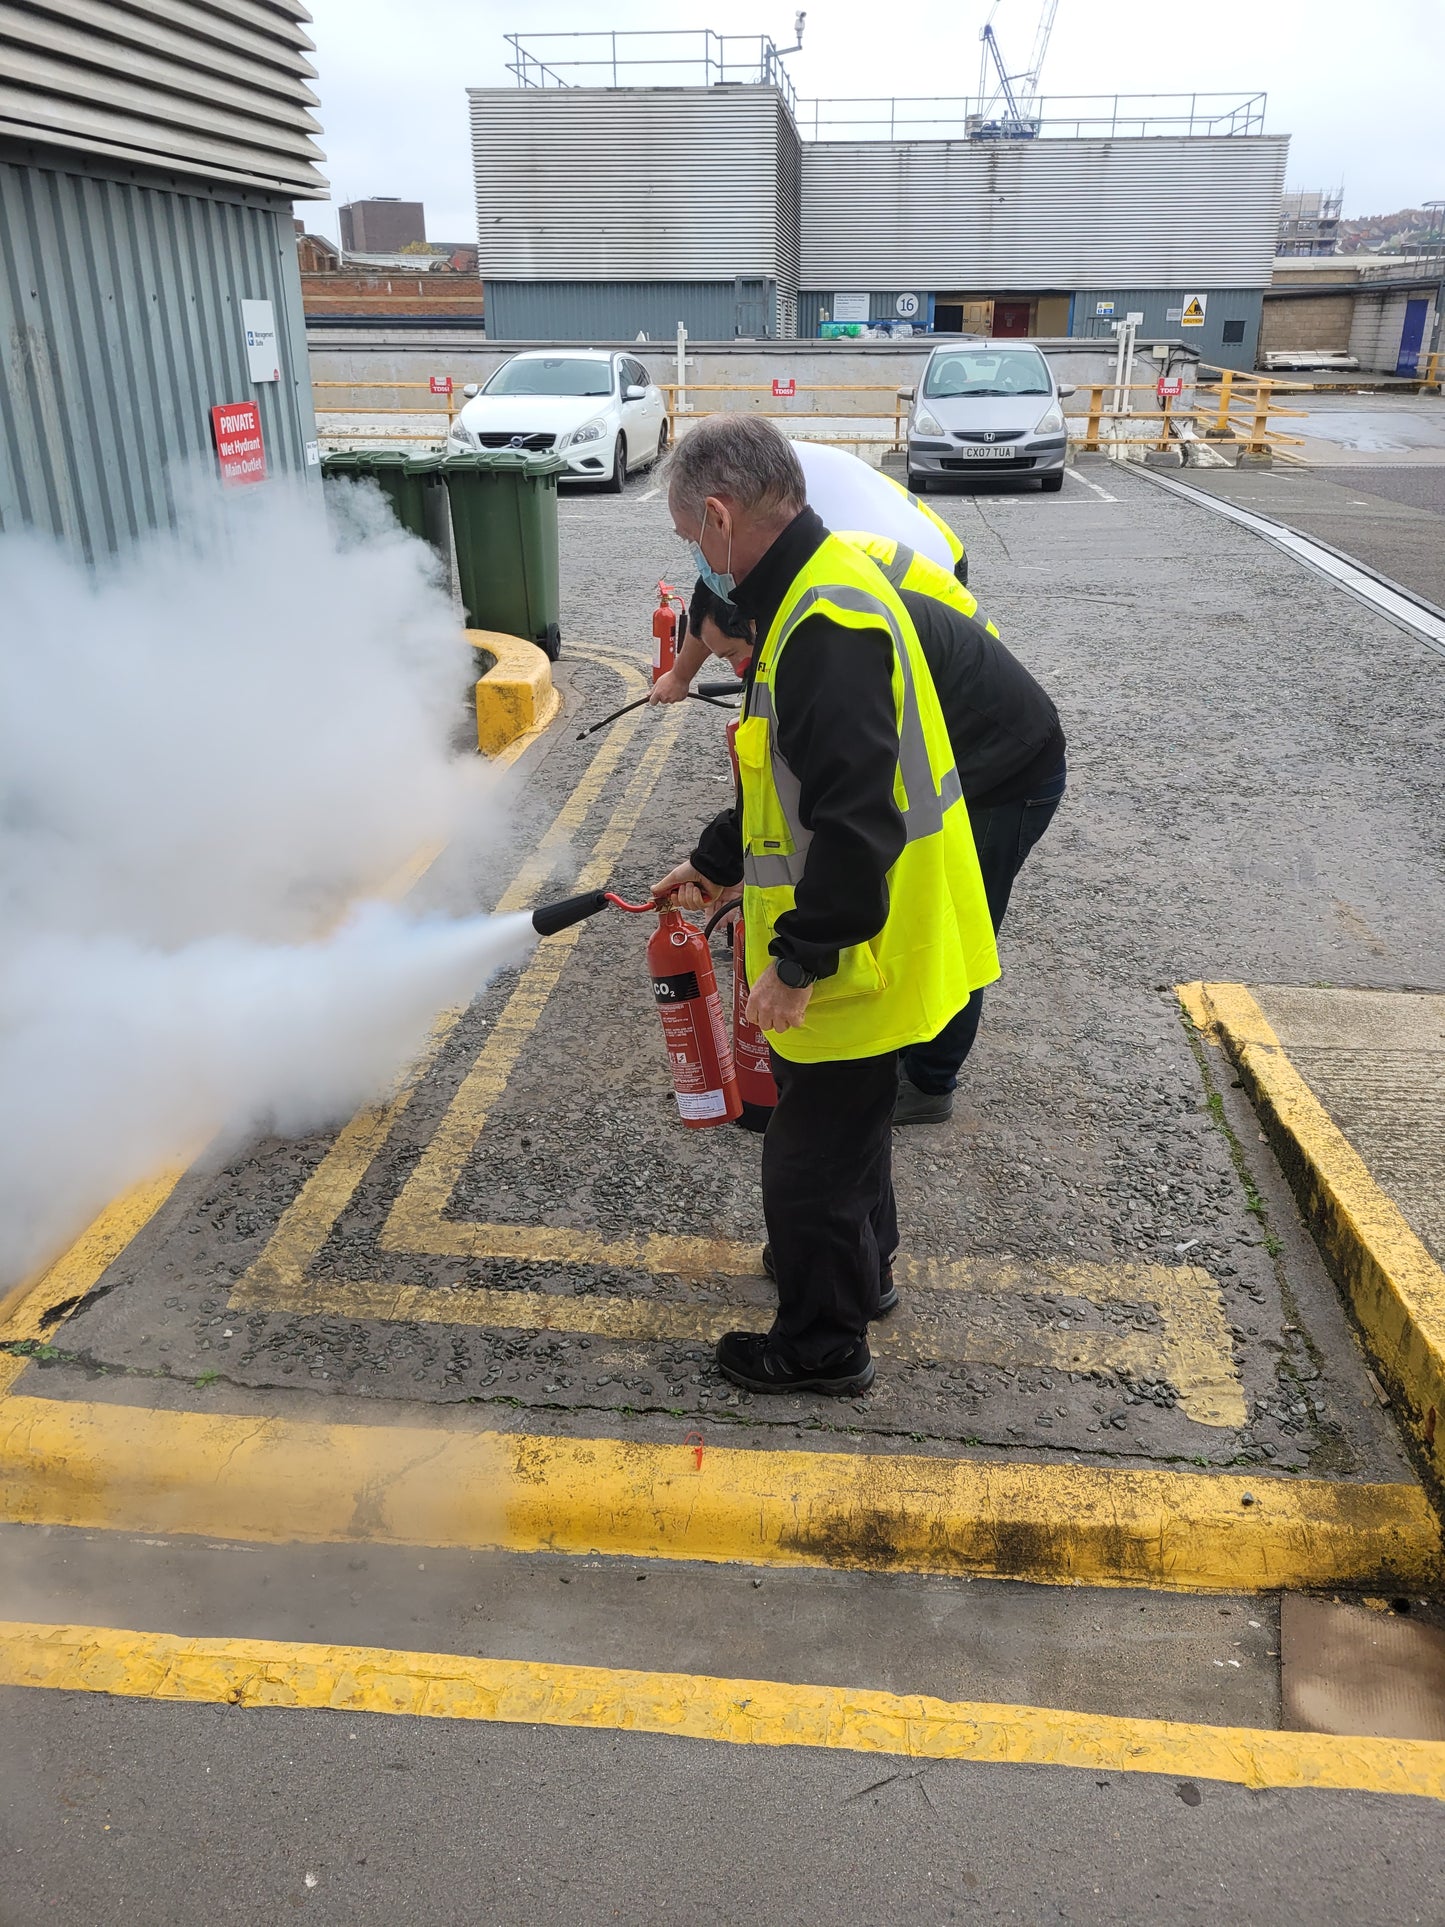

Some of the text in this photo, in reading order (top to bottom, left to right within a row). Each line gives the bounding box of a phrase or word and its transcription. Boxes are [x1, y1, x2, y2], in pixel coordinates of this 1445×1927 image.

[900, 298, 914, 311] 16
[220, 412, 255, 435] PRIVATE
[220, 437, 261, 457] Wet Hydrant
[966, 447, 1011, 457] CX07 TUA
[224, 457, 262, 478] Main Outlet
